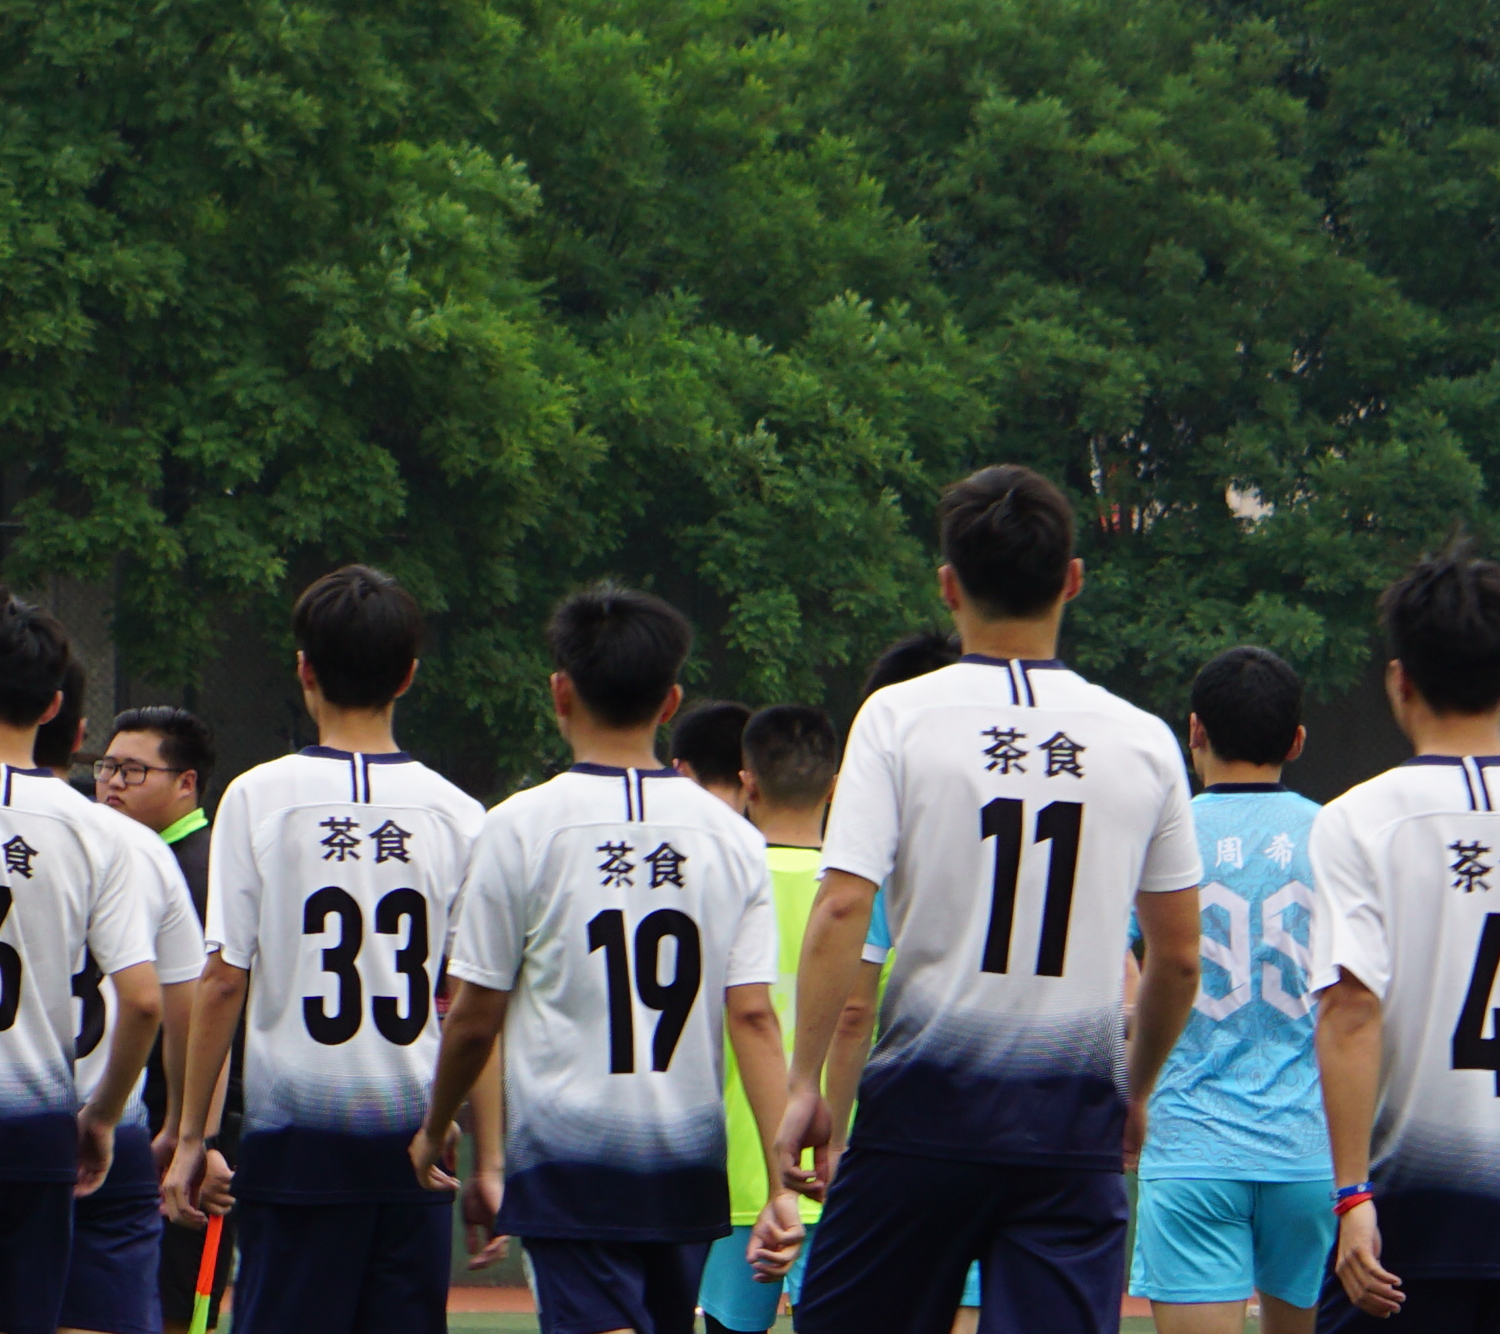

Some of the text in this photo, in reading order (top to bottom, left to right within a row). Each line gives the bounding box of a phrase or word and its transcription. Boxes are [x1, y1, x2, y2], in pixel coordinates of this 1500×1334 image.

[982, 726, 1086, 779] 茶食
[320, 816, 413, 864] 茶食
[596, 841, 688, 889] 茶食
[1215, 832, 1296, 870] 周希
[980, 798, 1084, 978] 11
[302, 885, 430, 1046] 33
[586, 908, 704, 1074] 19
